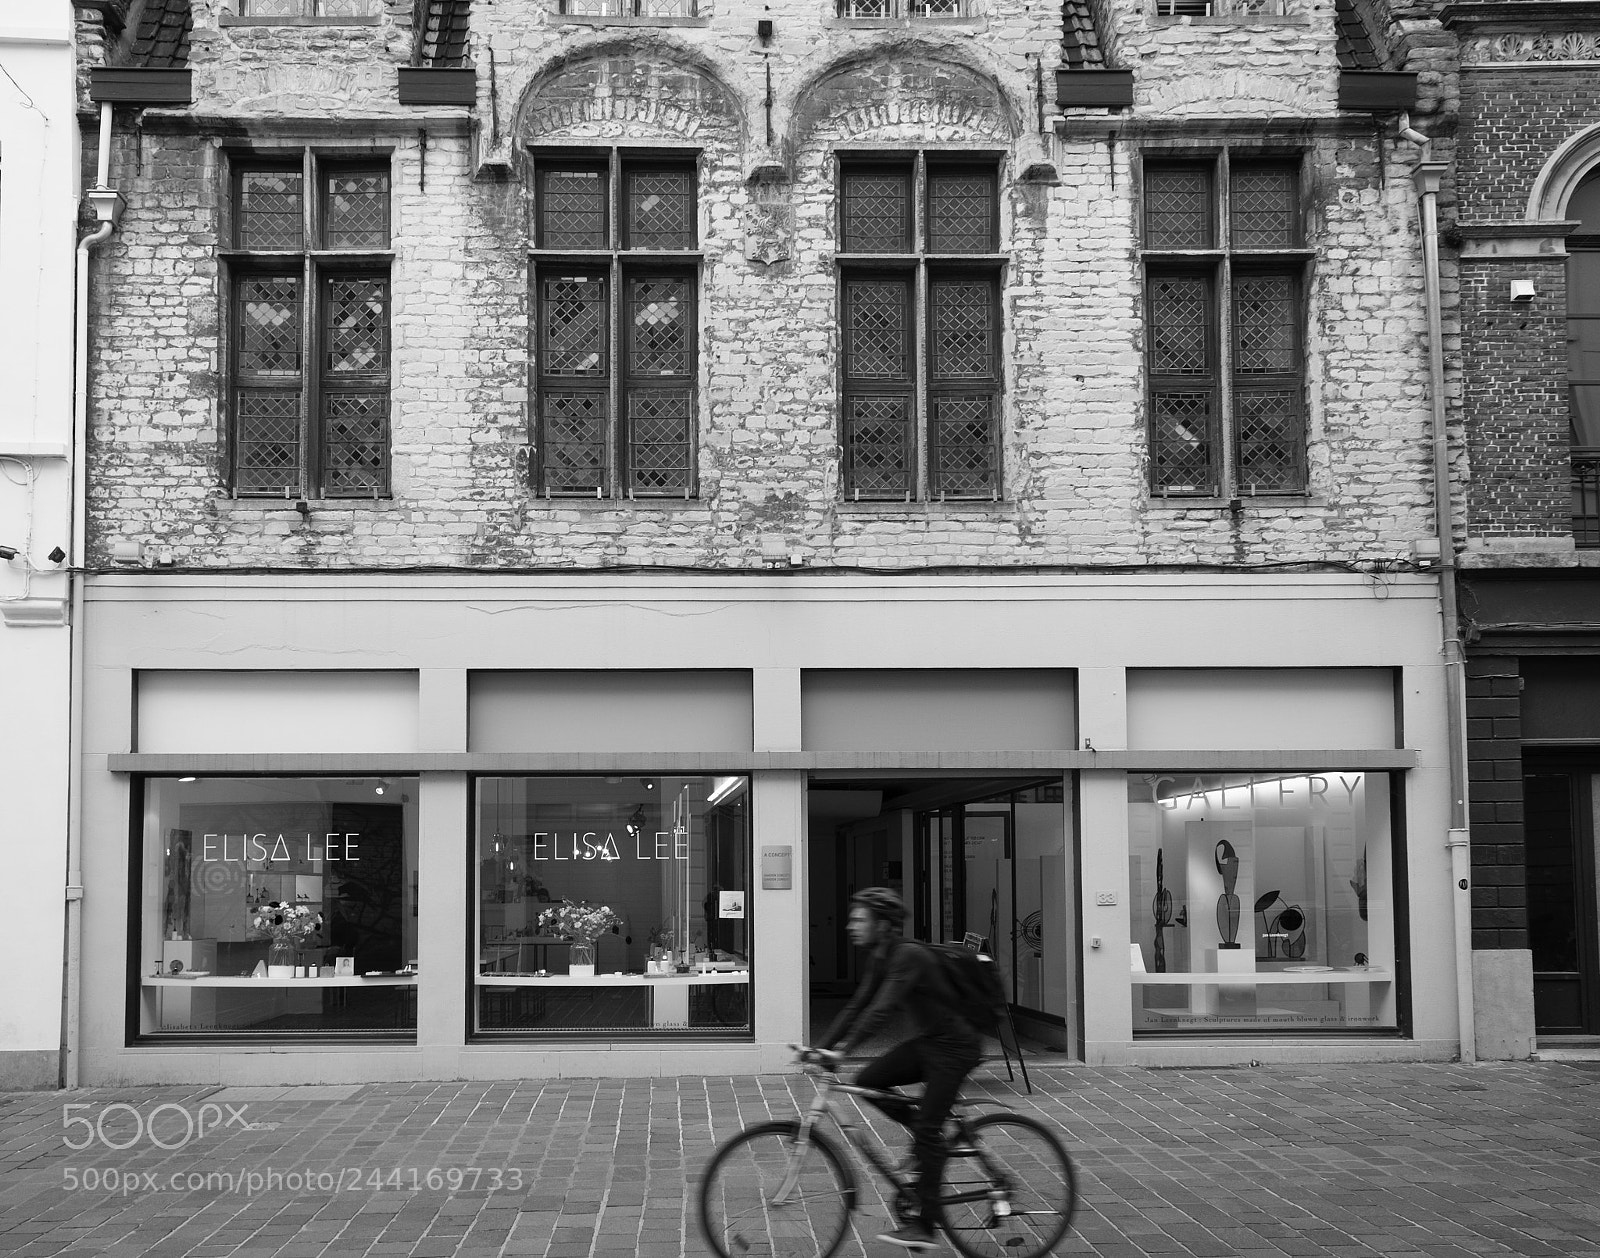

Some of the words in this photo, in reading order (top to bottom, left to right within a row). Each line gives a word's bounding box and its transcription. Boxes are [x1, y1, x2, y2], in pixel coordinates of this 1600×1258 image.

[1152, 775, 1362, 811] GALLERY
[203, 833, 291, 862] ELISA
[307, 833, 360, 861] LEE
[534, 832, 621, 860] ELISA
[636, 832, 689, 860] LEE
